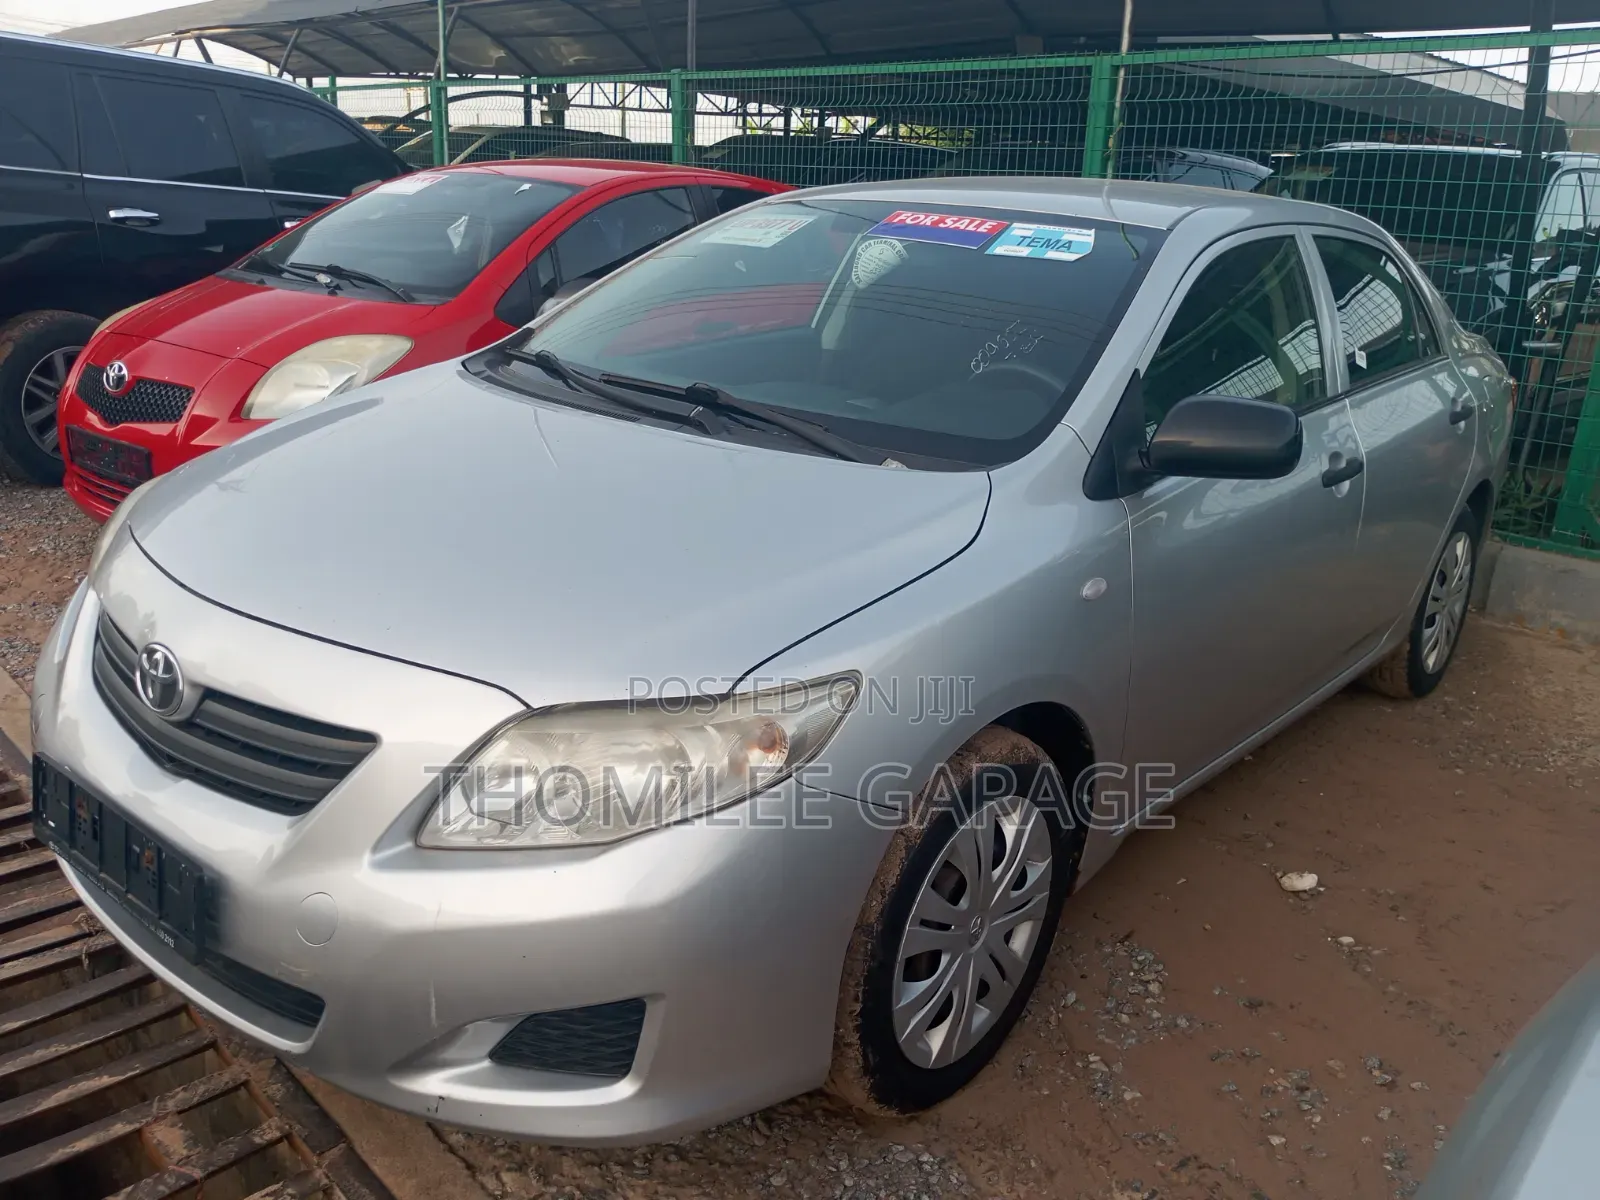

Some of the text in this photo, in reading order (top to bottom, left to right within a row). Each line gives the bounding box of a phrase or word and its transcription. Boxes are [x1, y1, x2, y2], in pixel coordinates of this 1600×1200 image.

[893, 213, 999, 233] FOR SALE
[861, 242, 873, 253] CAR
[873, 240, 899, 252] TERMINAL
[1016, 235, 1074, 251] TEMA
